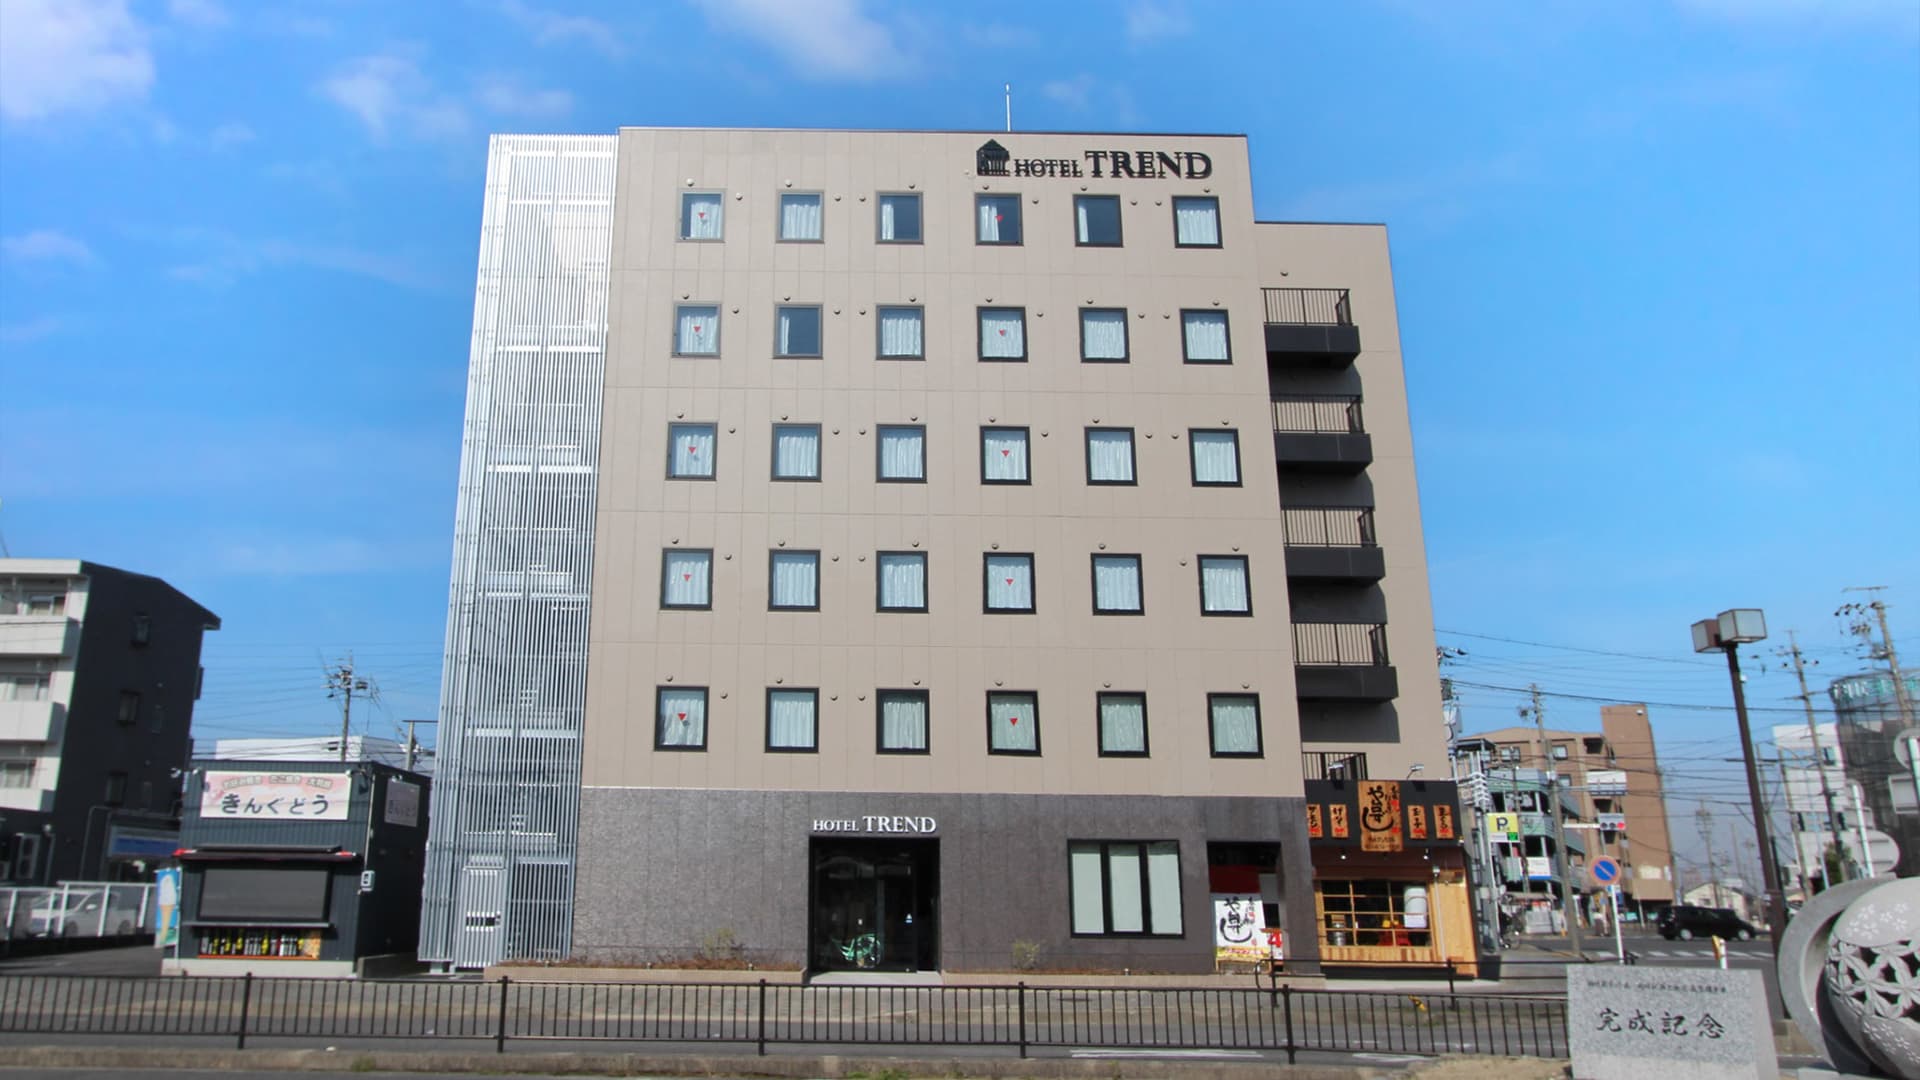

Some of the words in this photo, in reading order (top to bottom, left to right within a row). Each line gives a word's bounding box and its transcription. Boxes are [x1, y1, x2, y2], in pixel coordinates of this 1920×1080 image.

[1014, 159, 1083, 178] HOTEL
[1085, 150, 1213, 179] TREND
[221, 793, 329, 815] きんぐどう
[813, 819, 860, 833] HOTEL
[862, 815, 937, 834] TREND
[1496, 817, 1508, 831] P
[1596, 1007, 1725, 1039] 完成記念
